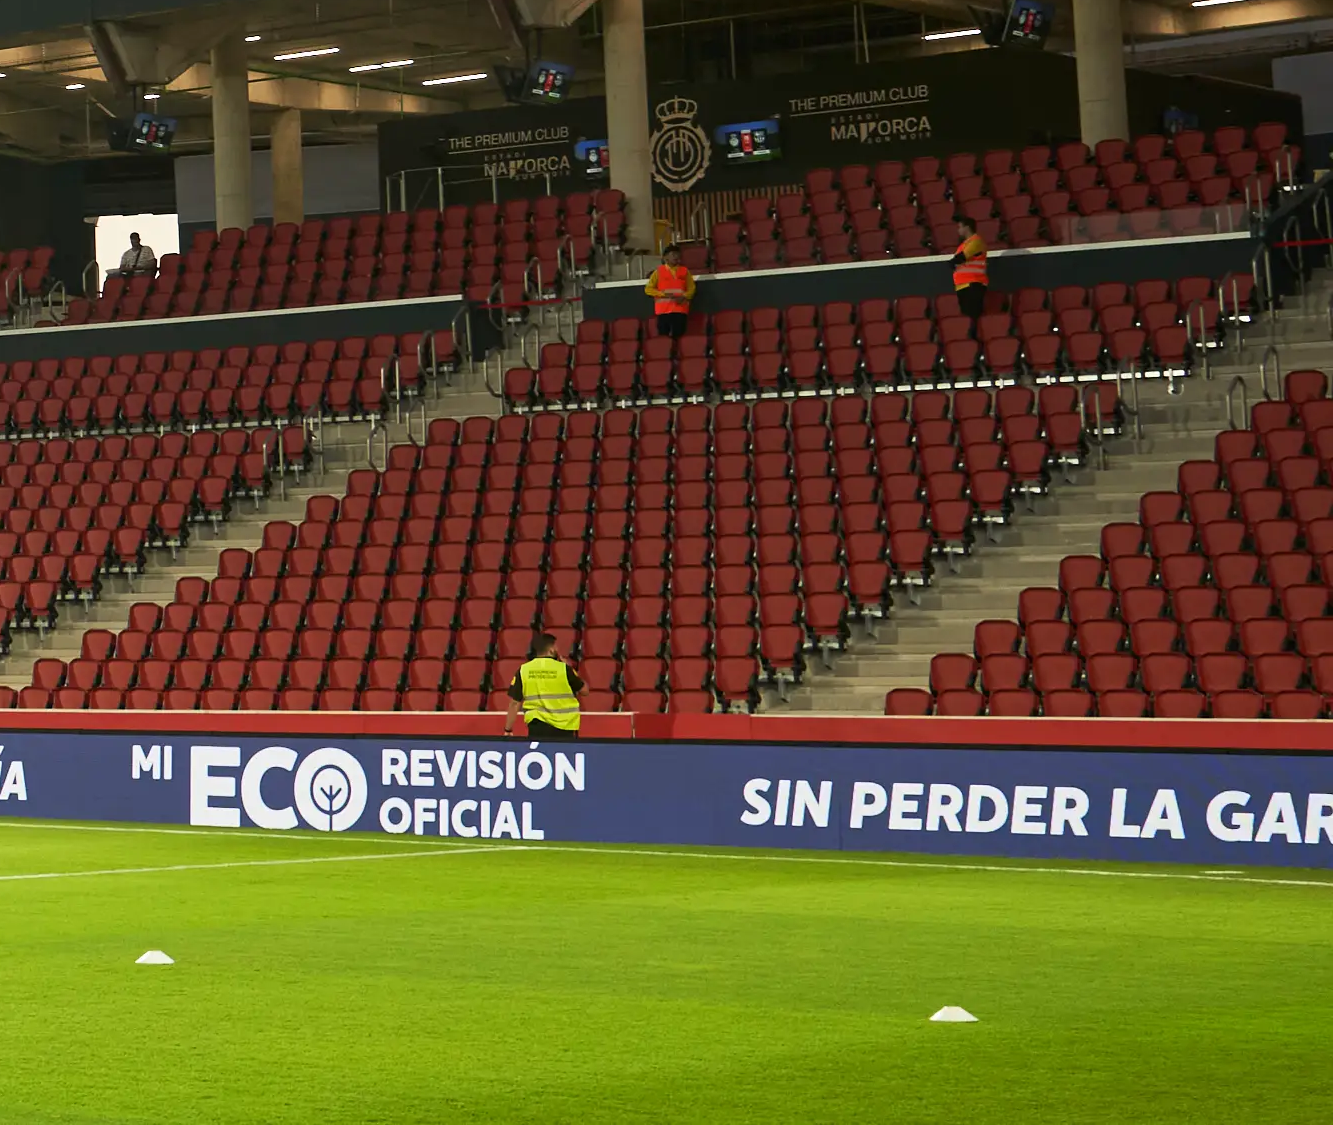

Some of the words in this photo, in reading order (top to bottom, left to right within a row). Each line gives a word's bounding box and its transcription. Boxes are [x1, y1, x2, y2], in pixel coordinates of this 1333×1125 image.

[788, 97, 816, 112] THE
[820, 89, 886, 108] PREMIUM
[889, 84, 929, 101] CLUB
[448, 136, 472, 150] THE
[475, 130, 532, 147] PREMIUM
[535, 126, 569, 140] CLUB
[132, 744, 173, 780] MI
[189, 744, 368, 832] ECO
[381, 741, 586, 791] REVISIÓN
[379, 797, 545, 840] OFICIAL
[740, 777, 832, 828] SIN
[849, 780, 1090, 837] PERDER
[1109, 787, 1186, 840] LA
